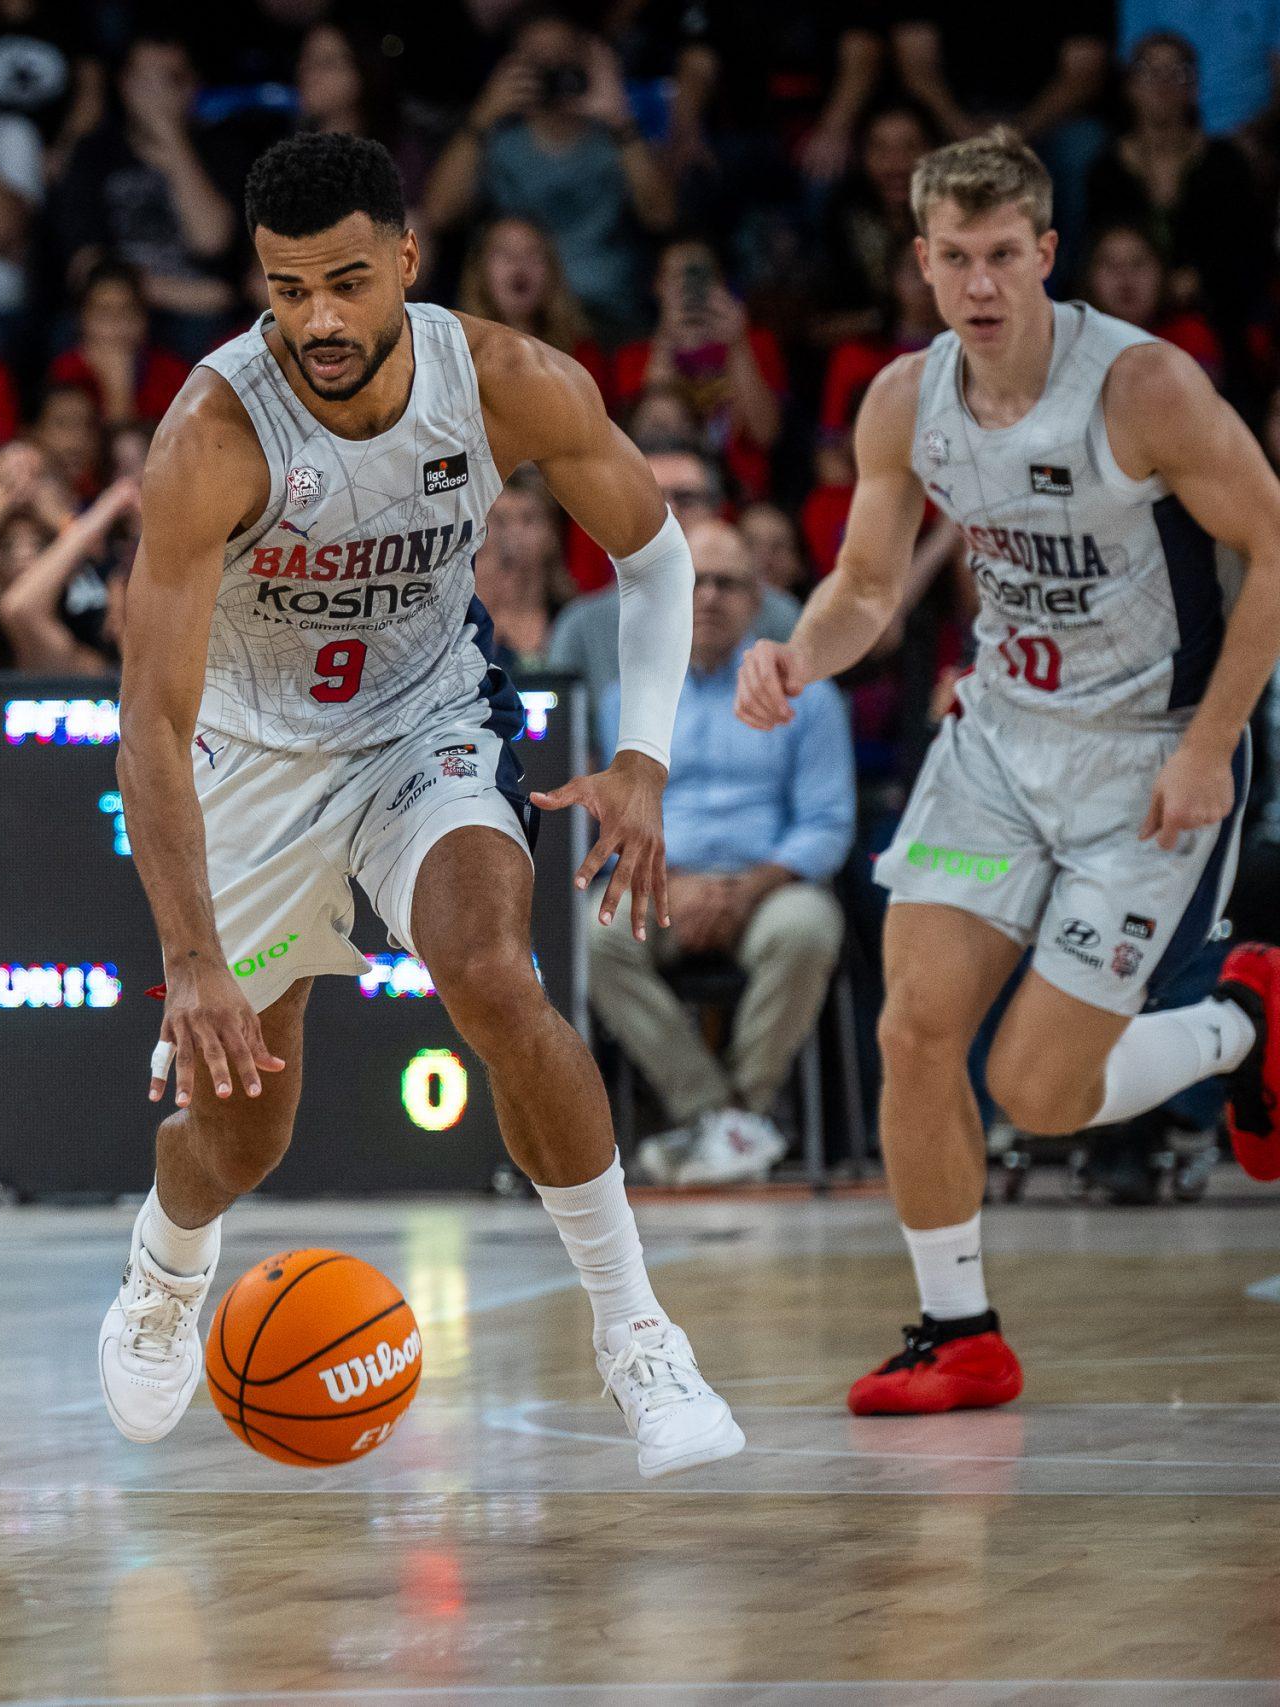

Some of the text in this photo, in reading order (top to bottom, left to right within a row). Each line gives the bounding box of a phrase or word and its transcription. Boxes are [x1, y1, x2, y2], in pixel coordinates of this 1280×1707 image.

[426, 469, 446, 483] liga
[427, 472, 468, 492] endesa
[256, 581, 437, 619] Kosne
[309, 638, 368, 703] 9
[998, 626, 1062, 692] 10
[438, 747, 468, 756] acb
[402, 1049, 467, 1131] 0
[318, 1327, 422, 1403] Wilson
